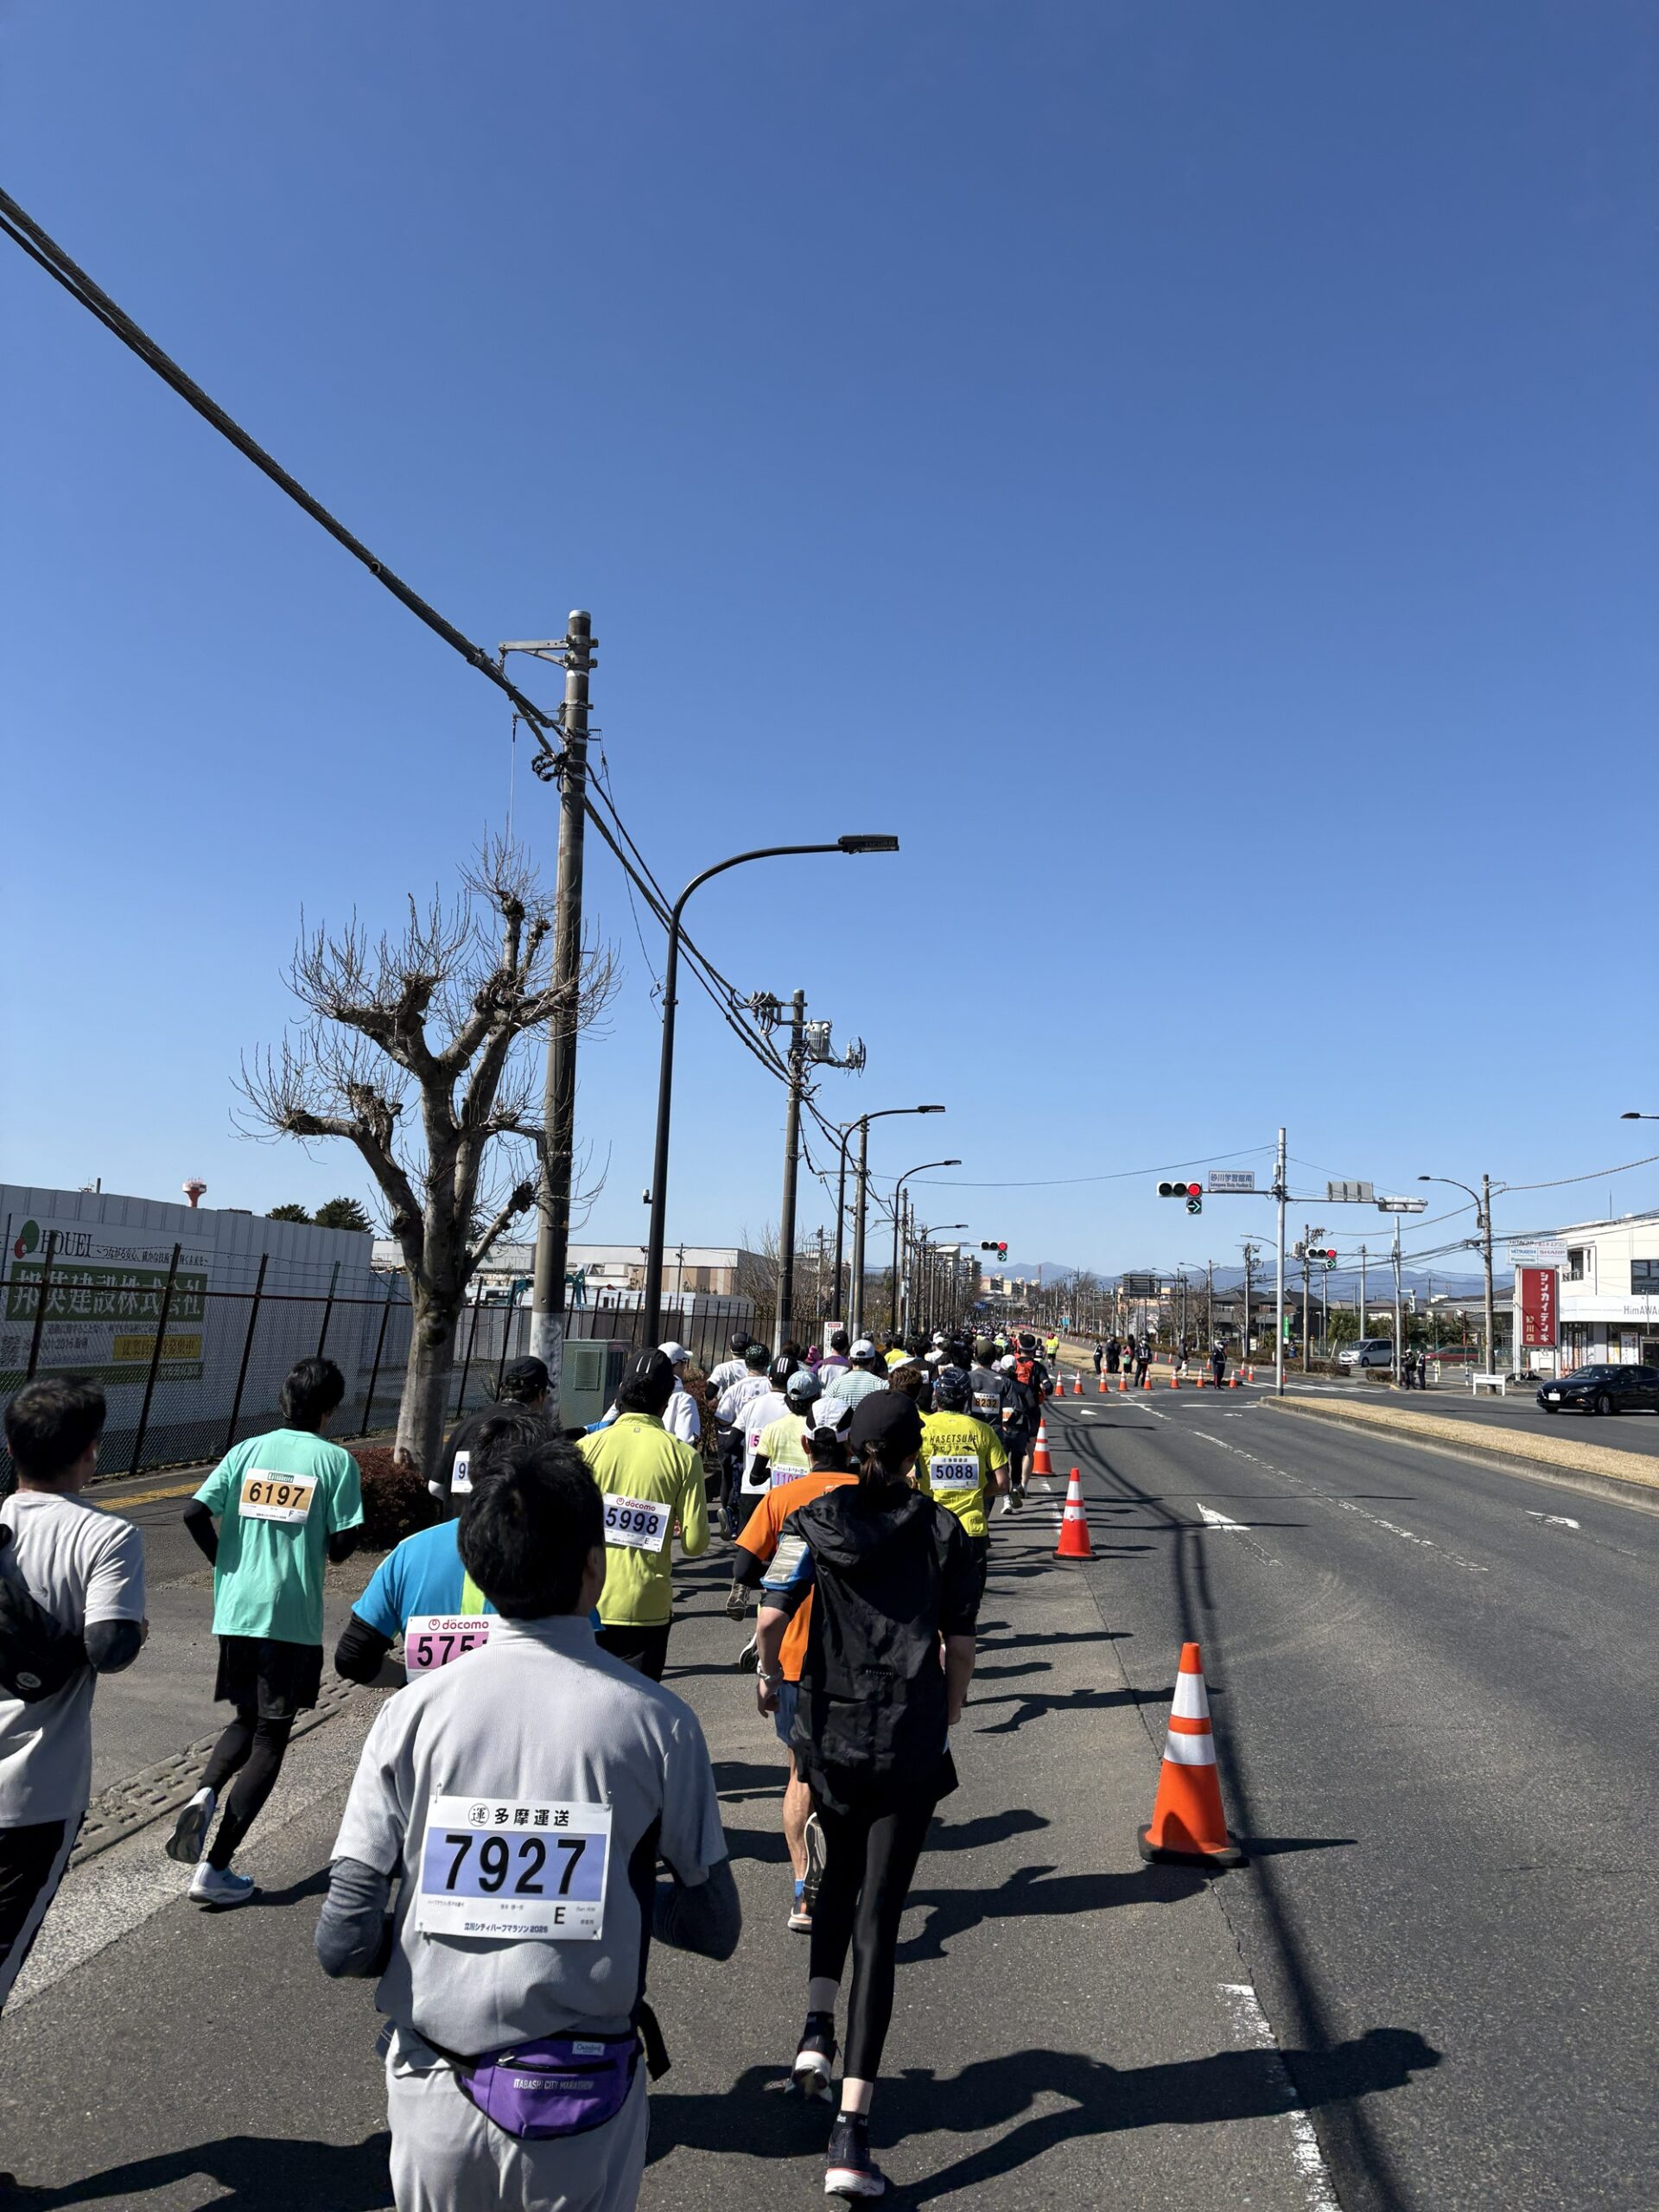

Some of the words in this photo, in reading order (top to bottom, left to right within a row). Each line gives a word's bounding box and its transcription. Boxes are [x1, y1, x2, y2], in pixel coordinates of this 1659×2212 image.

[936, 1465, 973, 1479] 5088
[249, 1482, 305, 1507] 6197
[625, 1500, 656, 1511] docomo
[606, 1507, 659, 1535] 5998
[442, 1619, 489, 1630] docomo
[416, 1635, 487, 1667] 575
[494, 1807, 570, 1827] 多摩運送
[445, 1834, 587, 1896] 7927
[554, 1906, 566, 1925] E
